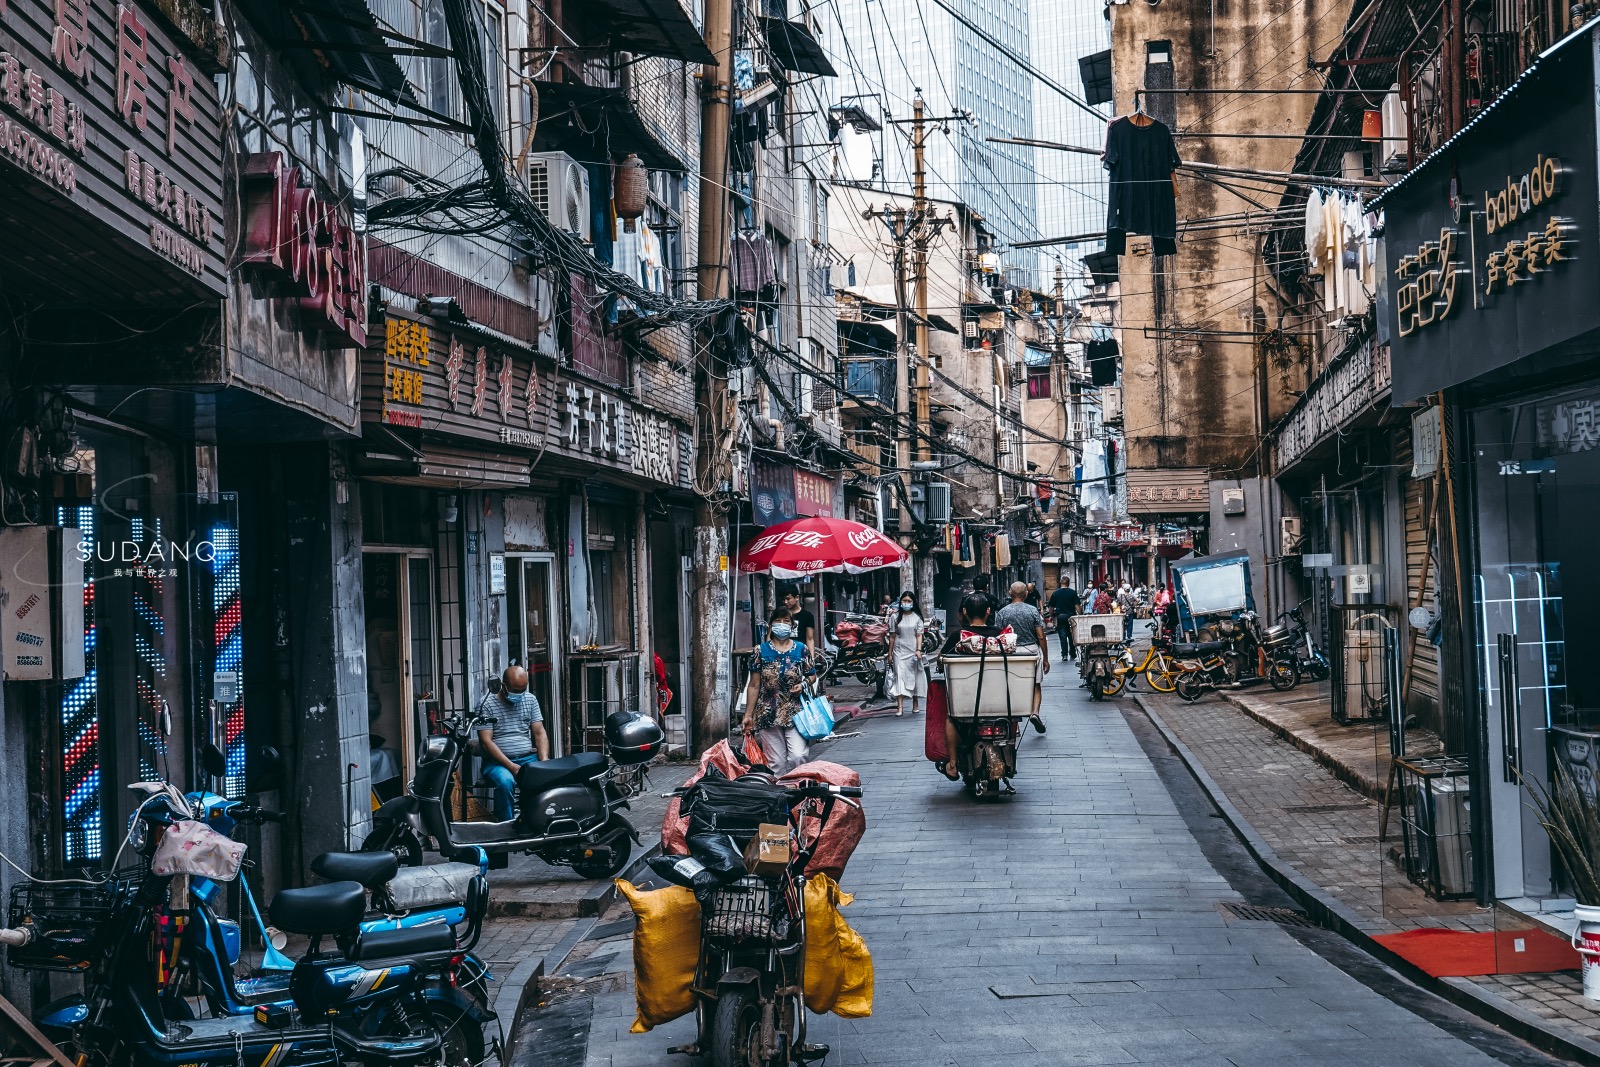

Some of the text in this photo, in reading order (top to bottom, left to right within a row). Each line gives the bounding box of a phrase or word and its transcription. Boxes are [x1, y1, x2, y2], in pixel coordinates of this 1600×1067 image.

[1485, 153, 1556, 236] babado
[1485, 215, 1562, 297] 芦荟专卖
[386, 320, 430, 367] 四季养生
[220, 685, 231, 697] 推
